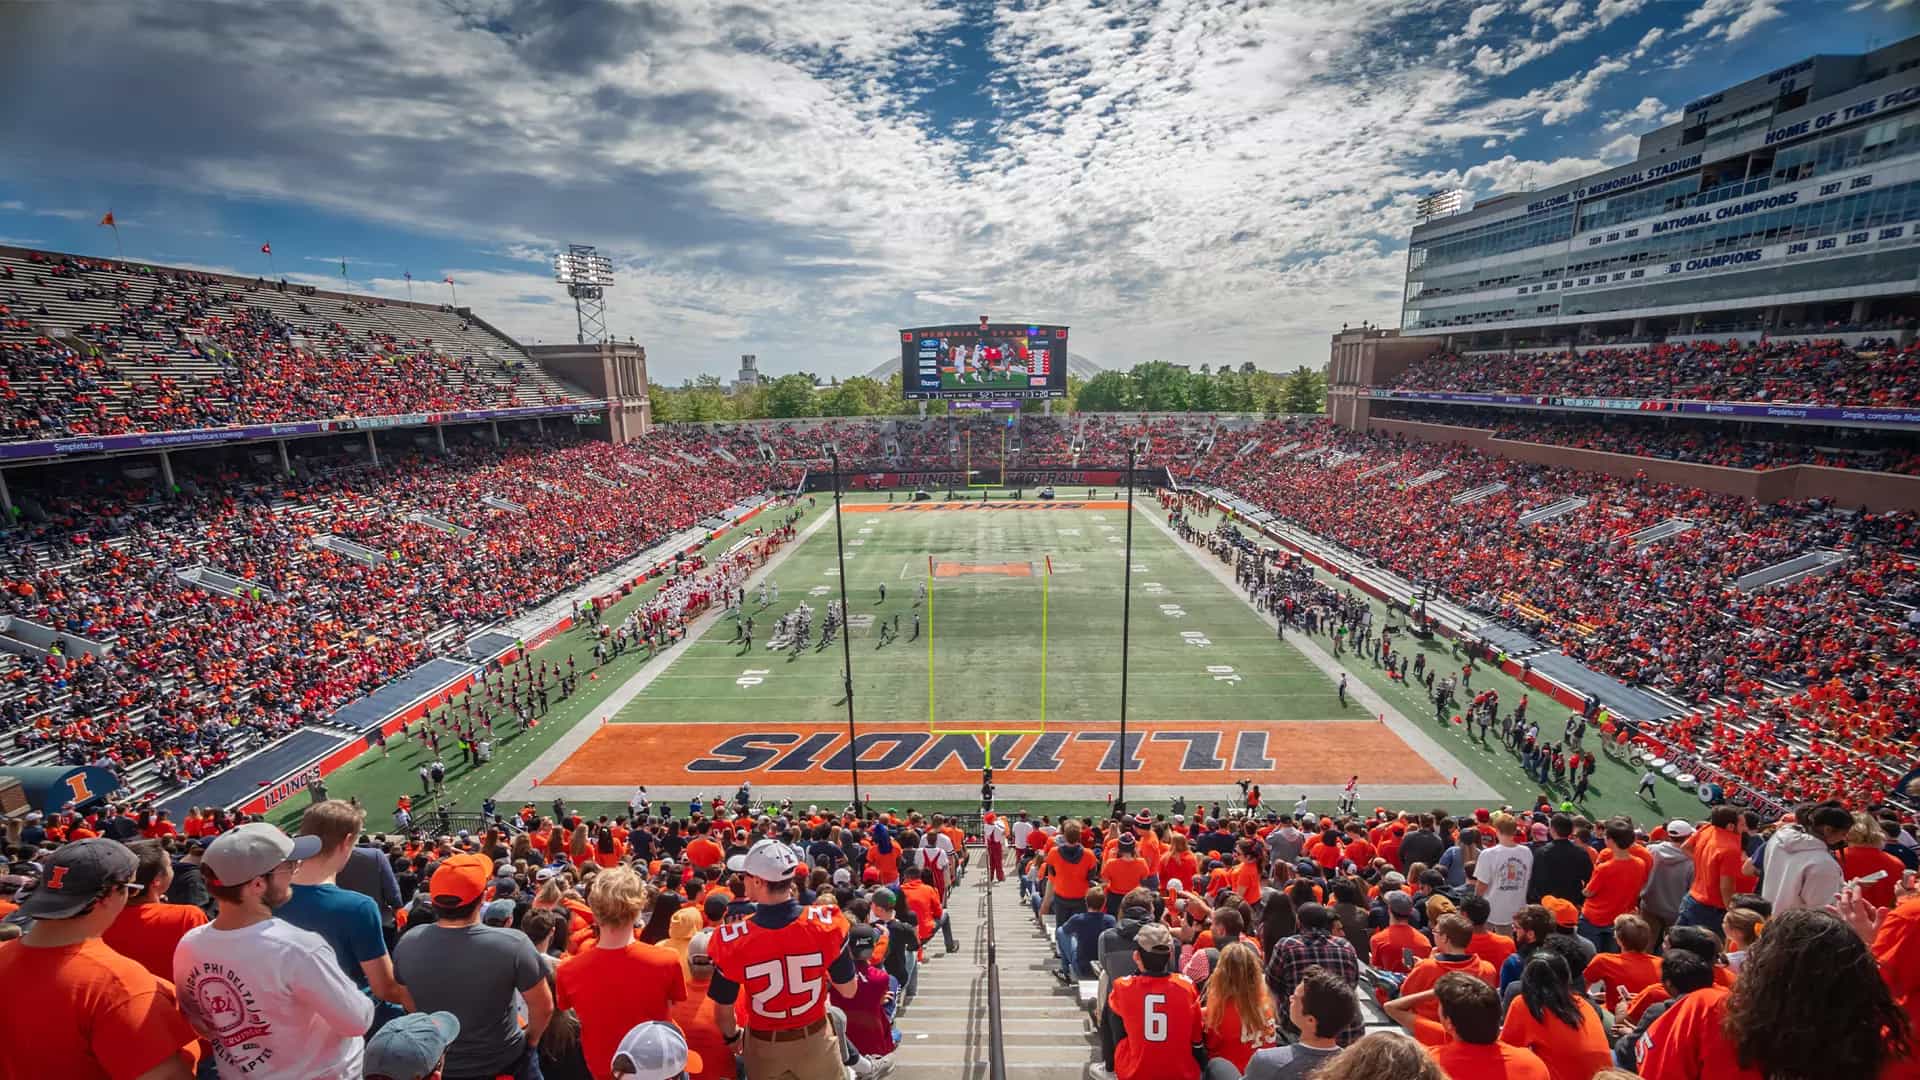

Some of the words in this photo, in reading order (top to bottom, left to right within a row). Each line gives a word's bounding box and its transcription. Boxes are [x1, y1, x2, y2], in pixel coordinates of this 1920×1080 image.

[1765, 120, 1811, 144] HOME
[1815, 111, 1836, 128] OF
[1843, 100, 1876, 120] THE
[1880, 86, 1920, 107] FIG
[1527, 194, 1570, 212] WELCOME
[1572, 189, 1586, 200] TO
[1588, 172, 1644, 195] MEMORIAL
[1647, 154, 1702, 180] STADIUM
[1652, 212, 1712, 234] NATIONAL
[1716, 191, 1799, 219] CHAMPIONS
[1686, 249, 1762, 270] CHAMPIONS
[685, 731, 1275, 772] ILLINOIS
[264, 765, 321, 808] ILLINOS
[48, 867, 69, 889] I
[720, 921, 748, 943] 5
[203, 963, 223, 976] PHI
[227, 970, 255, 1006] DELTA
[745, 953, 823, 1019] 25
[1144, 994, 1168, 1042] 6
